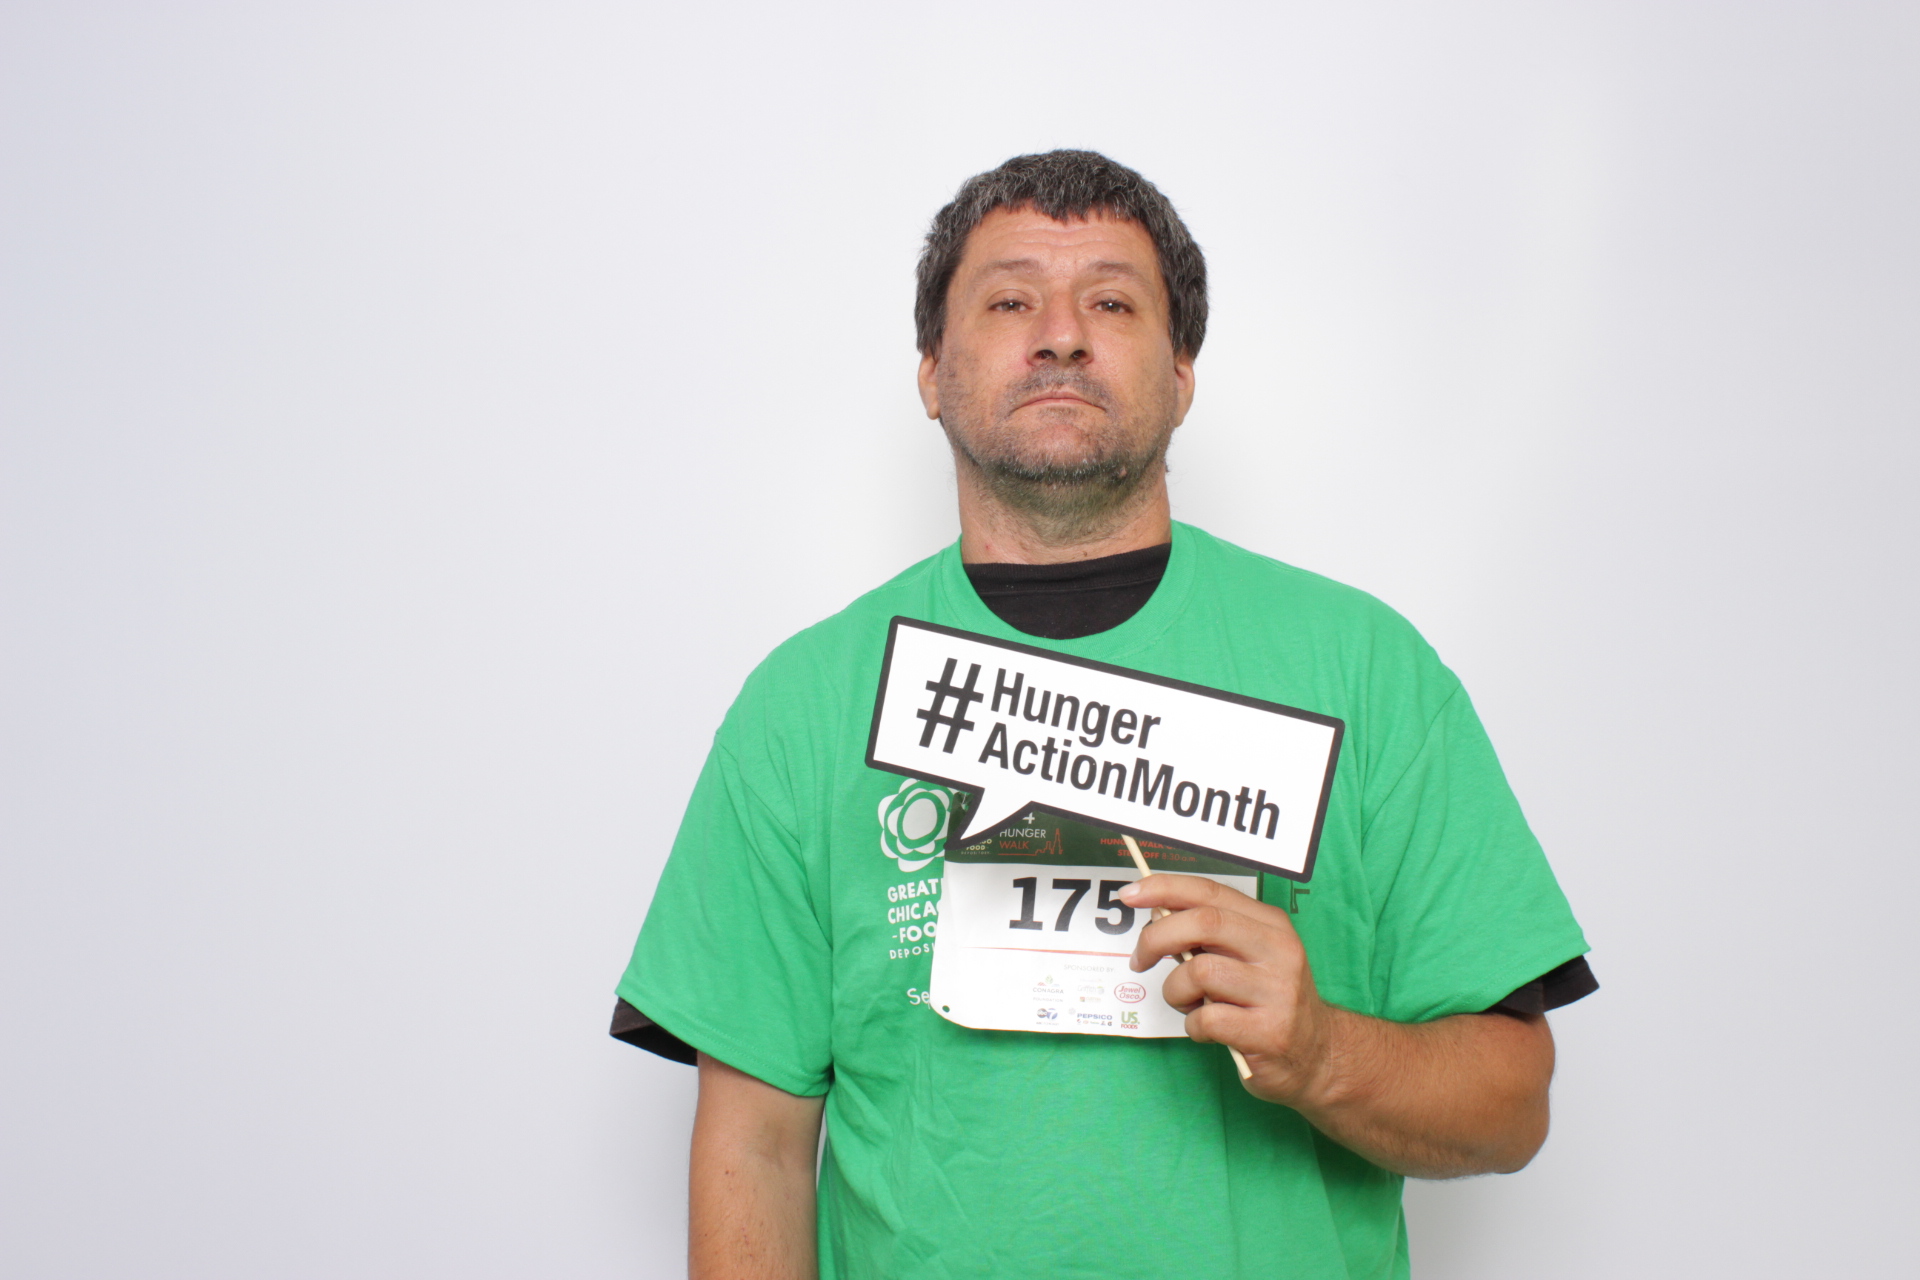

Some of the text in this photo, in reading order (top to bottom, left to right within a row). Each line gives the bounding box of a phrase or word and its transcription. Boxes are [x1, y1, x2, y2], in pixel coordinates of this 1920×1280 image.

[978, 723, 1281, 840] ActionMonth
[998, 828, 1046, 839] HUNGER
[999, 841, 1030, 850] WALK
[1100, 838, 1126, 846] HUNG
[1117, 849, 1133, 857] STE
[1143, 851, 1160, 859] OFF
[1161, 852, 1180, 861] 8:30
[887, 878, 944, 903] GREAT
[1009, 876, 1152, 936] 175
[887, 900, 940, 924] CHICA
[892, 921, 938, 943] -FOO
[1063, 964, 1105, 973] SPONSORED
[1032, 986, 1064, 995] CONAGRA
[1118, 985, 1141, 994] Jewel
[906, 987, 931, 1009] Se
[1076, 1012, 1113, 1021] PEPSICO
